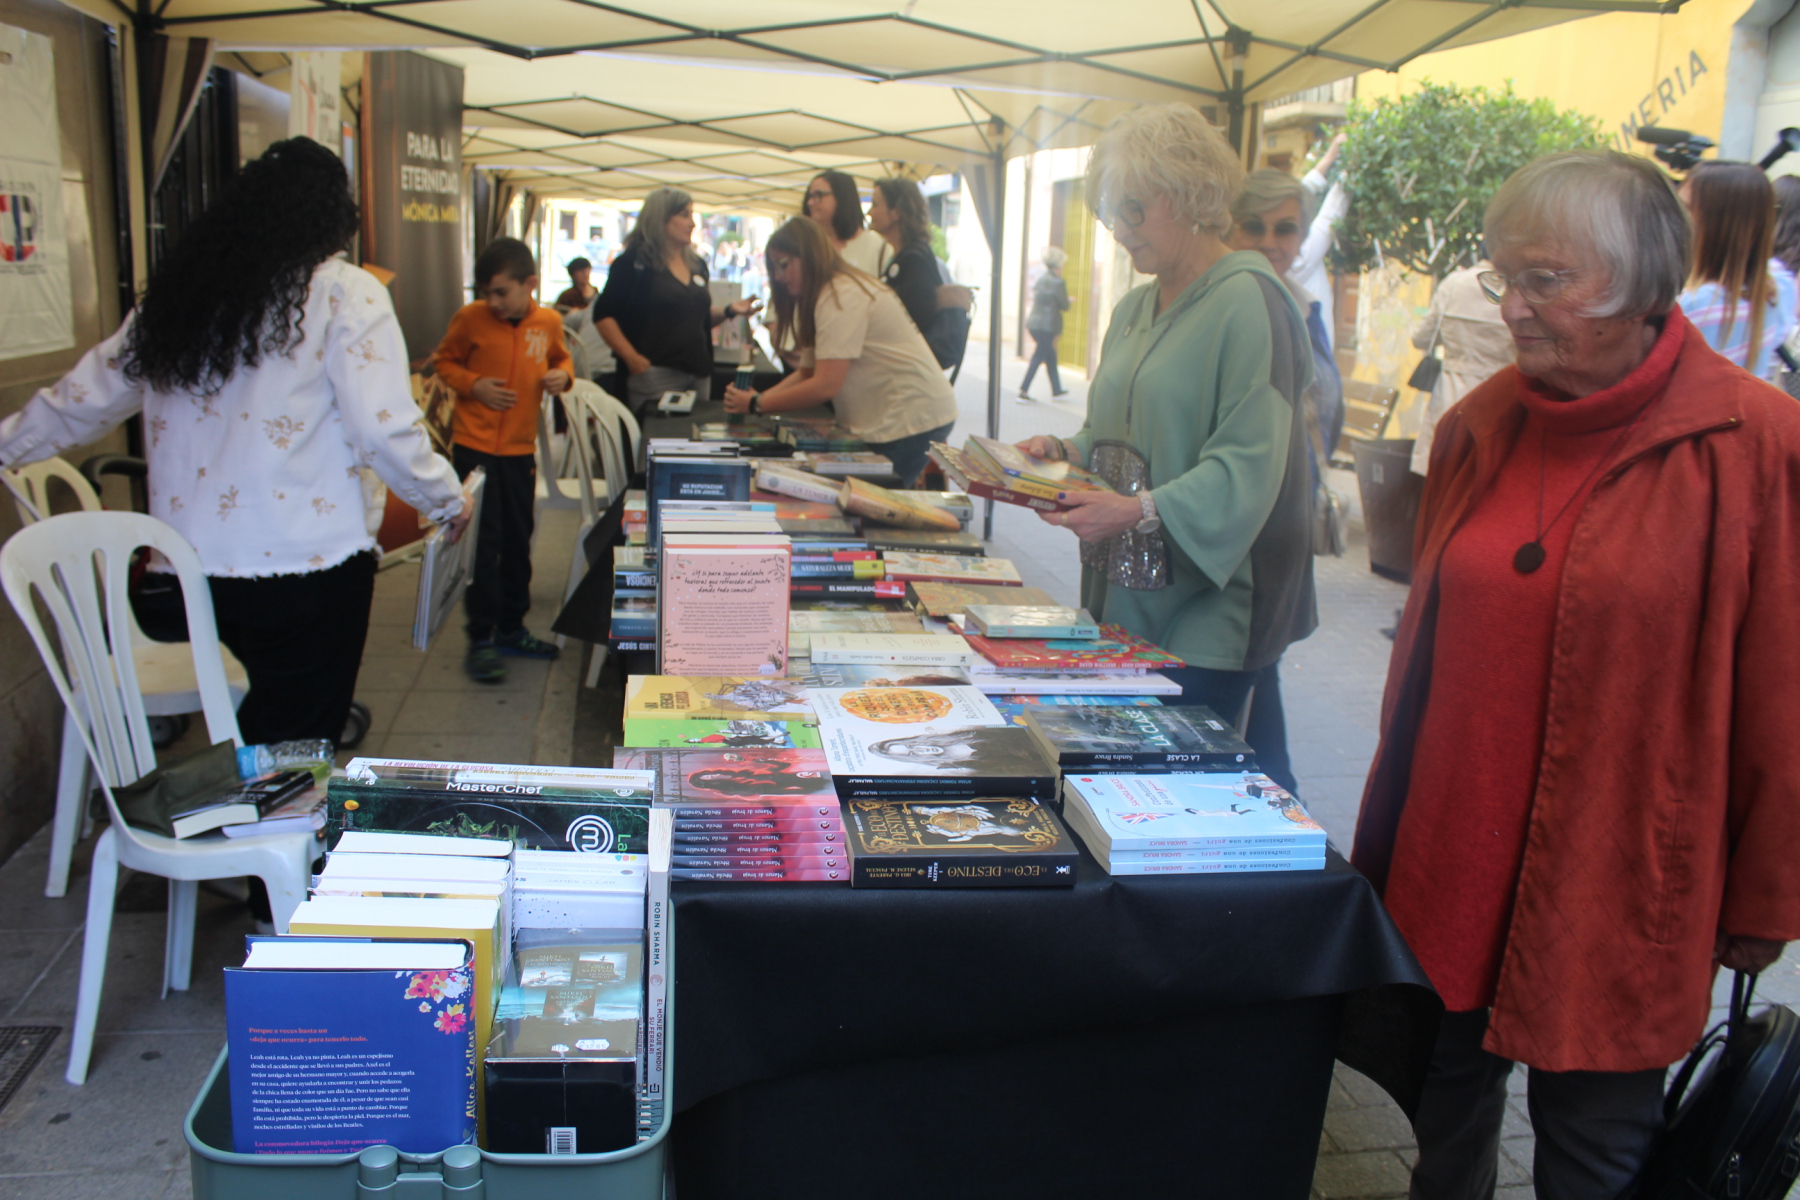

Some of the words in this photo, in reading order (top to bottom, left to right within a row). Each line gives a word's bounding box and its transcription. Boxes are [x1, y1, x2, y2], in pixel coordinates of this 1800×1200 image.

[407, 132, 439, 161] PARA
[440, 138, 455, 162] LA
[401, 164, 459, 195] ETERNIDAD
[402, 198, 439, 222] MÓNICA
[617, 641, 638, 650] JESÚS
[858, 692, 882, 718] RIQUEZA
[889, 694, 908, 715] DINERO
[915, 690, 938, 718] COMPRAR
[962, 704, 979, 720] Robin
[1125, 709, 1159, 733] CLASE
[1150, 734, 1171, 746] LA
[446, 782, 543, 794] MasterChef
[1110, 778, 1128, 790] BRUCE
[1122, 790, 1140, 806] SANDRA
[867, 815, 888, 832] ECO
[880, 806, 909, 841] DESTINO
[618, 834, 631, 851] La
[948, 866, 1001, 876] DESTINO
[1014, 865, 1040, 876] ECO
[649, 1017, 654, 1025] SU
[249, 1027, 272, 1036] Porque
[320, 1053, 335, 1062] pinta.
[367, 1053, 394, 1061] espejismo
[465, 1030, 476, 1080] Kellen
[465, 1081, 477, 1119] Alice
